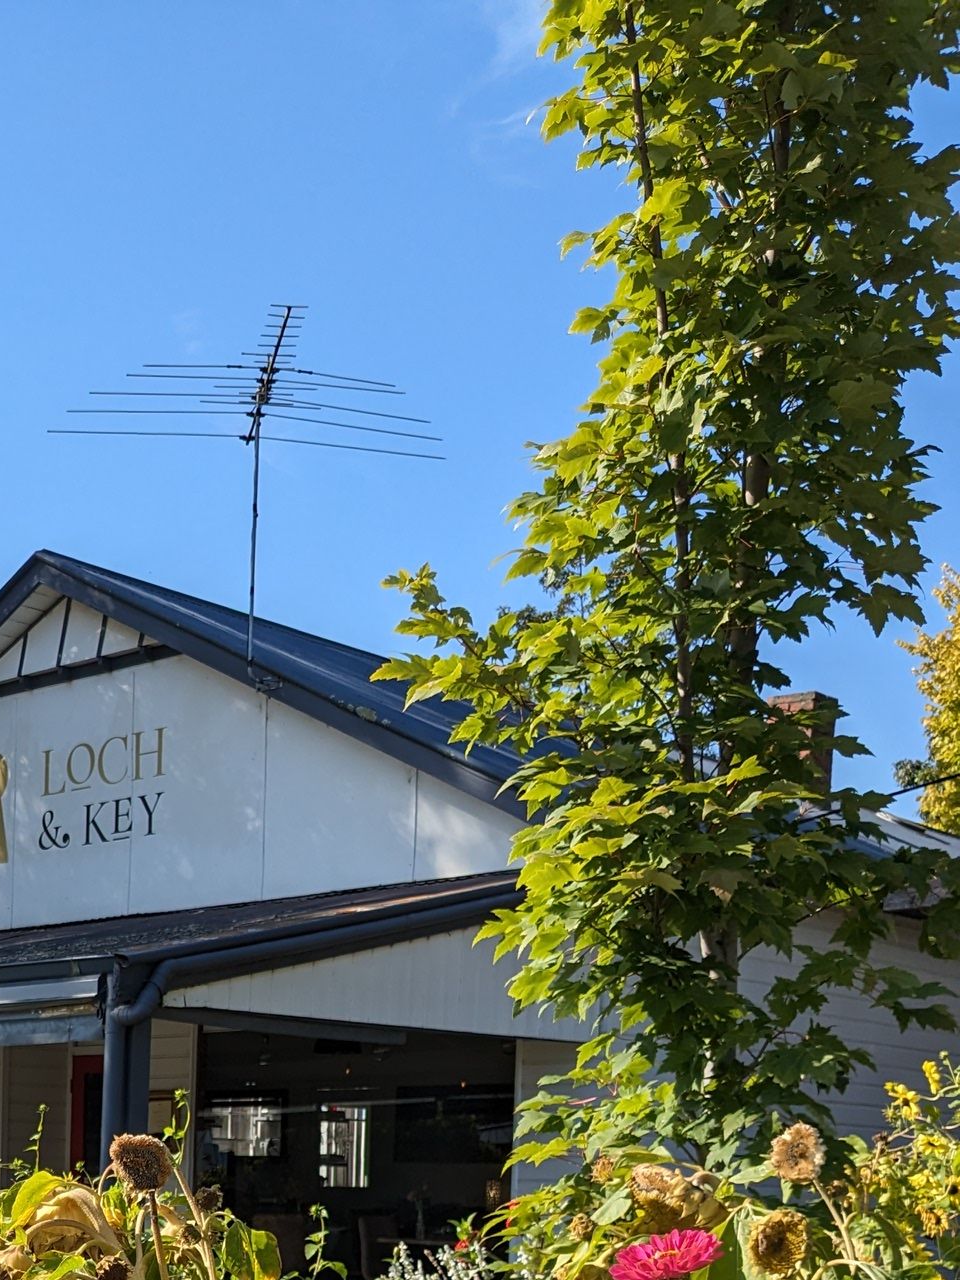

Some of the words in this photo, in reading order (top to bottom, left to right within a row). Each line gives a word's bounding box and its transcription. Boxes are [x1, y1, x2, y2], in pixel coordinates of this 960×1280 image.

[40, 726, 168, 797] LOCH
[38, 810, 70, 851] &
[82, 791, 165, 846] KEY
